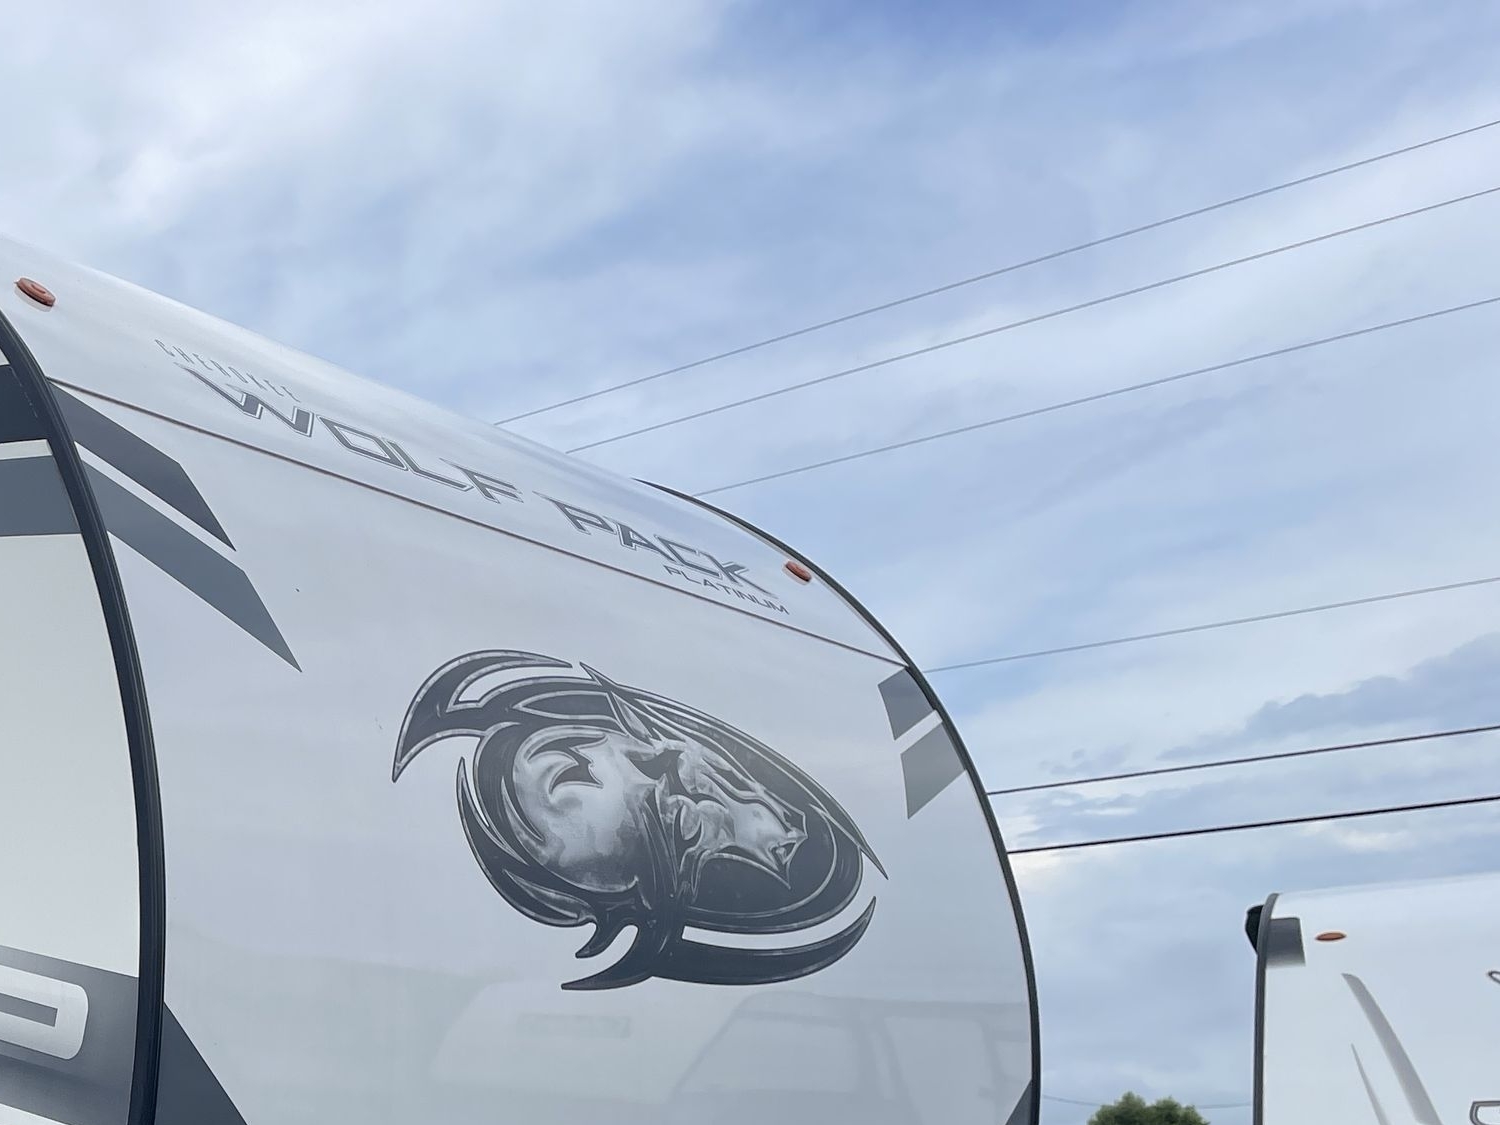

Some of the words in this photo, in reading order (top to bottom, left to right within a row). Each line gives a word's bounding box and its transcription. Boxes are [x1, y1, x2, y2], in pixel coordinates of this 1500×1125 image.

[174, 361, 524, 504] WOLF
[532, 490, 780, 601] PACK
[662, 564, 790, 616] PLATINUM
